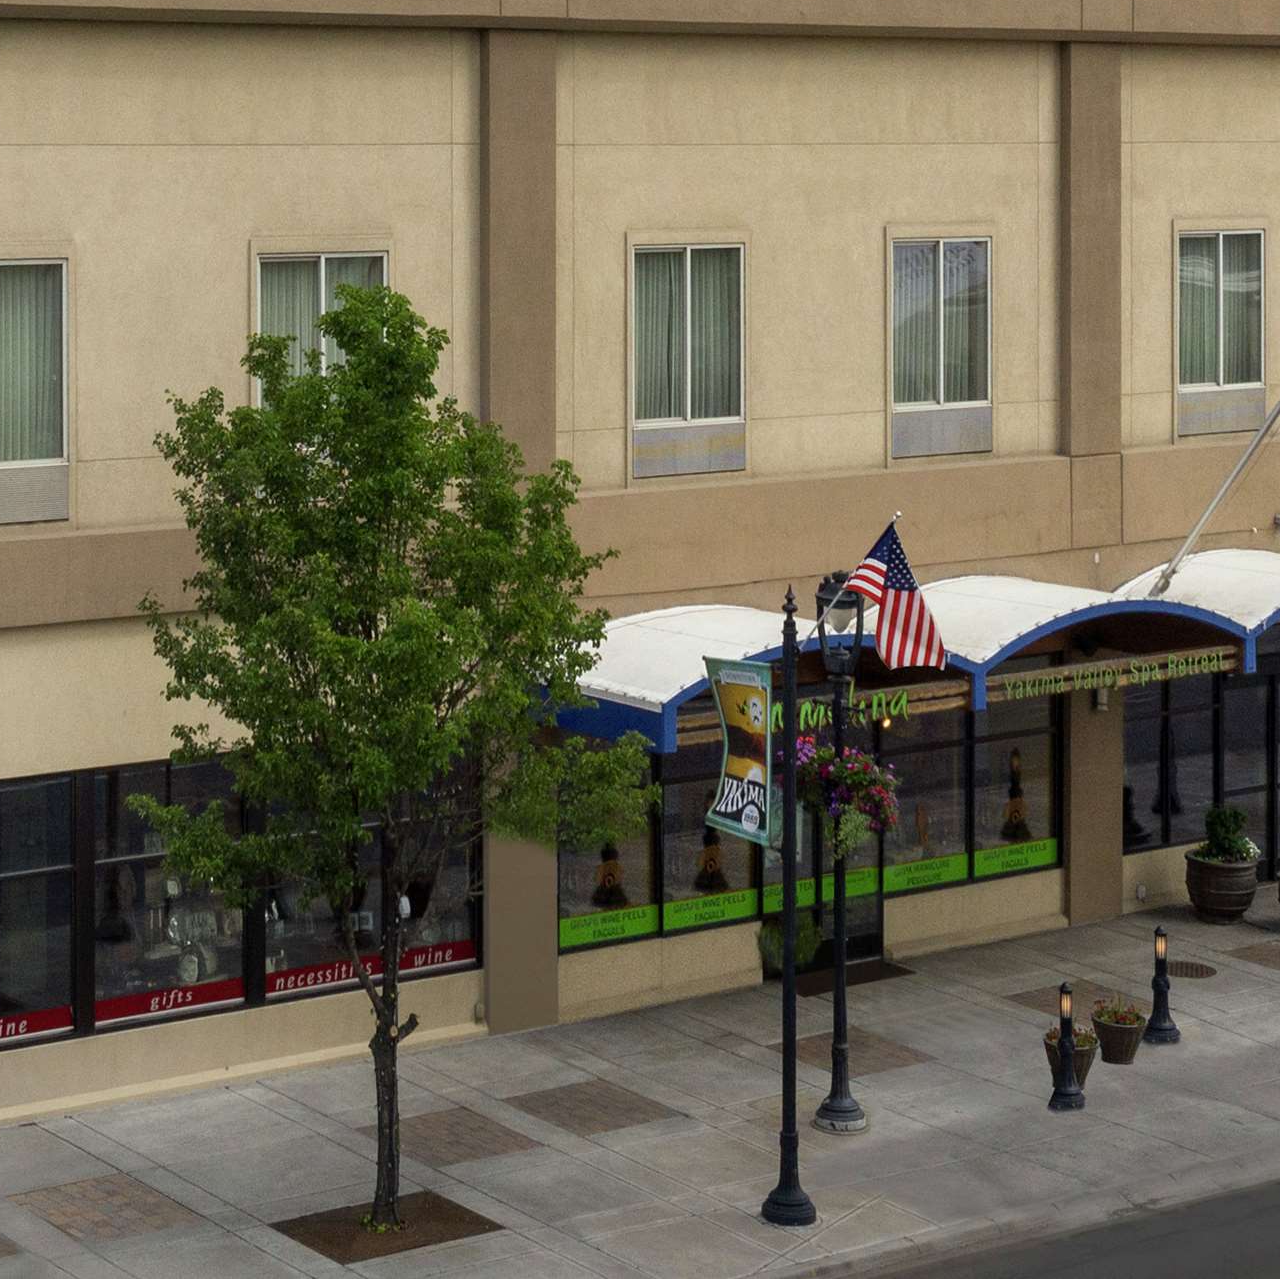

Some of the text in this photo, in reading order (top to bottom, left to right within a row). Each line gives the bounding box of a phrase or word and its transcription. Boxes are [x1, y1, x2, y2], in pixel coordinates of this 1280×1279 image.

[1004, 653, 1228, 700] Yakima Valley Spa Retreat
[716, 776, 766, 814] YAKIMA
[414, 947, 454, 968] wine
[275, 961, 373, 990] necessitis
[150, 988, 194, 1011] gifts
